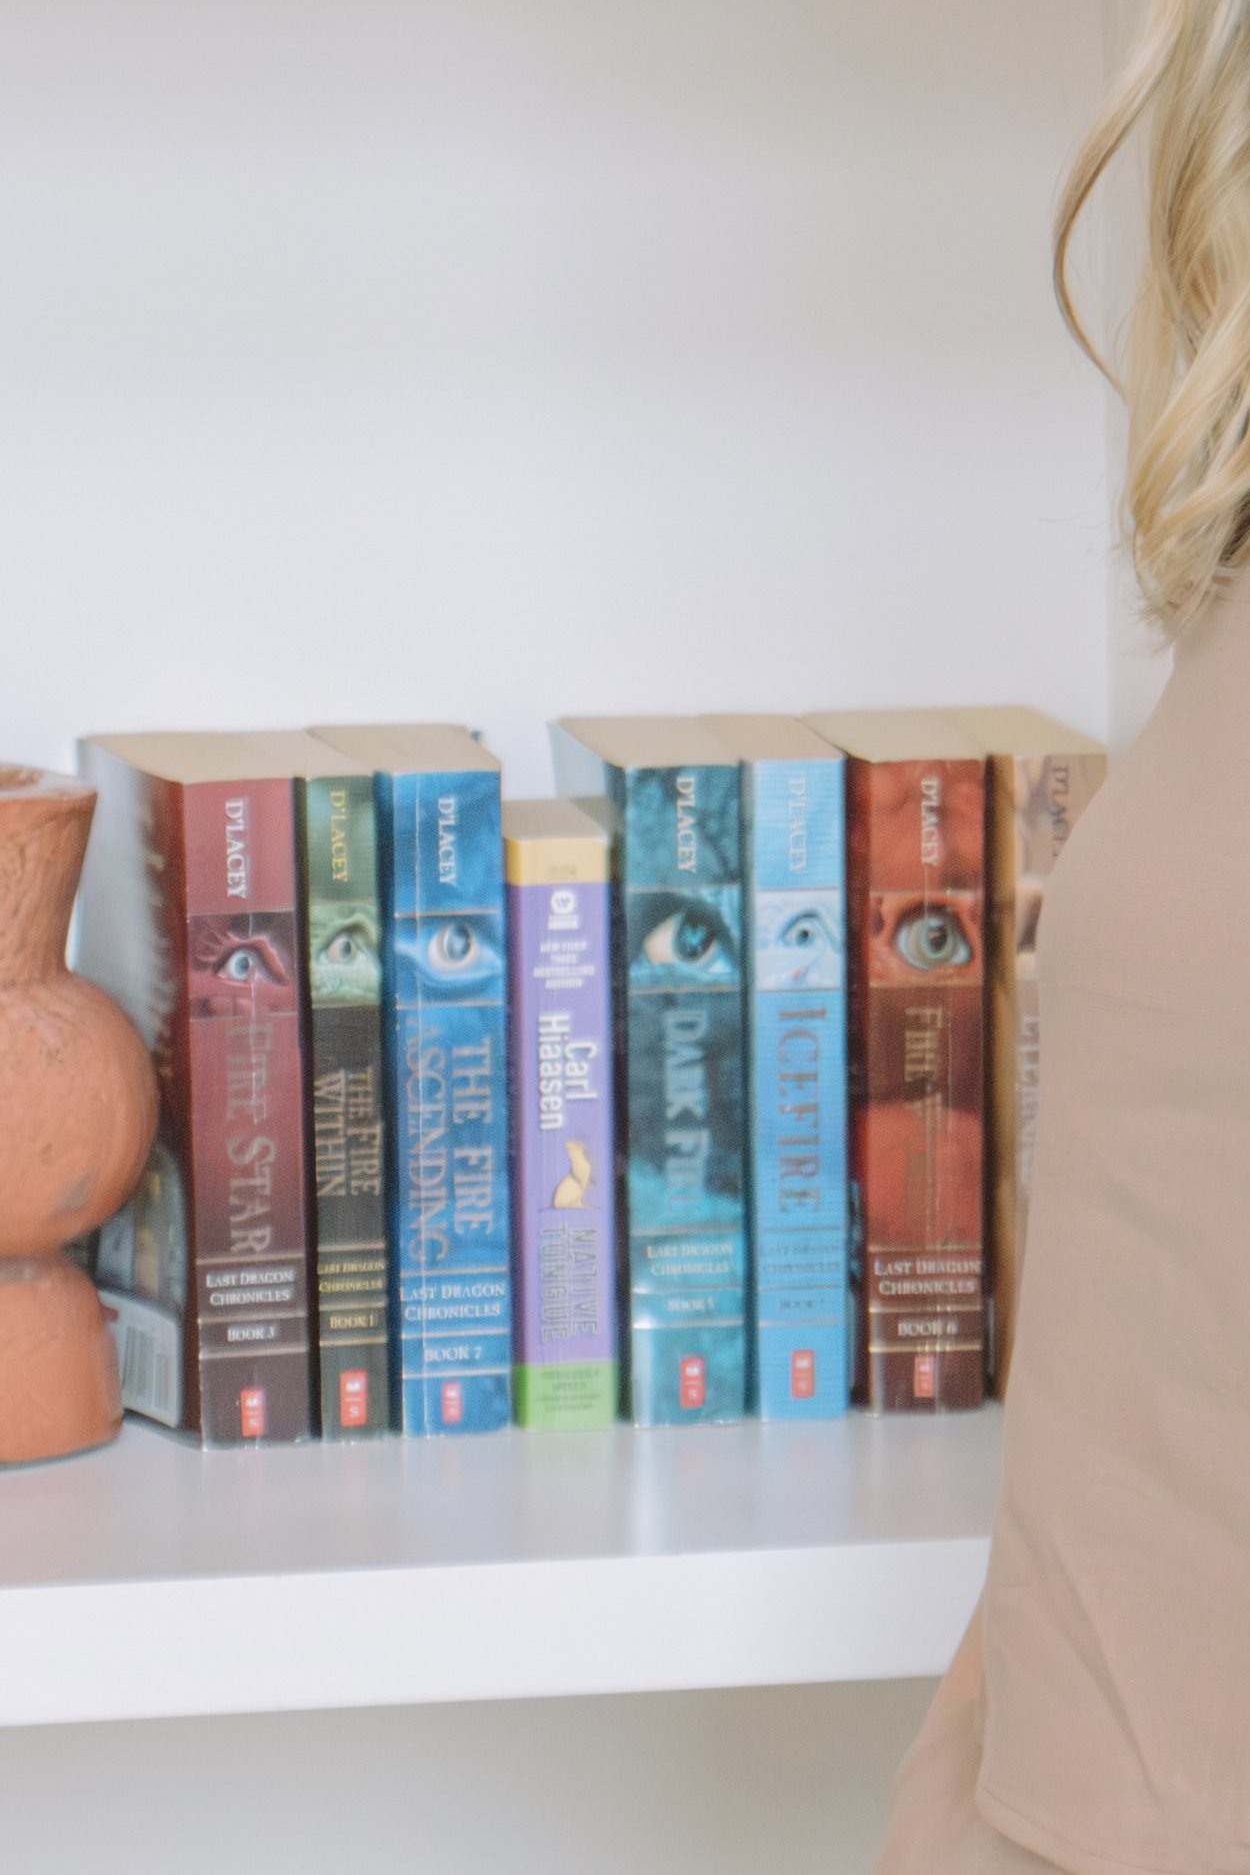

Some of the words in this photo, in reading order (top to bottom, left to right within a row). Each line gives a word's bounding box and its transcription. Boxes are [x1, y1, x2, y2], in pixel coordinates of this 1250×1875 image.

[225, 798, 248, 899] D'LACEY
[330, 789, 348, 883] D'LACEY
[437, 796, 457, 886] D'LACEY
[676, 775, 697, 873] D'LACEY
[920, 777, 941, 867] D'LACEY
[348, 1066, 373, 1119] THE
[452, 1037, 493, 1124] THE
[538, 1012, 571, 1131] Hiaasen
[564, 1040, 598, 1100] Carl
[777, 1007, 827, 1213] ICEFIRE
[314, 1069, 346, 1197] WITHIN
[348, 1124, 382, 1197] FIRE
[405, 1015, 449, 1263] ASCENDING
[226, 1136, 277, 1253] STAR
[453, 1146, 494, 1235] FIRE
[206, 1271, 238, 1288] LAST
[239, 1268, 295, 1285] DRAGON
[209, 1289, 292, 1306] CHRONICLES
[400, 1285, 437, 1302] LAST
[440, 1282, 507, 1300] DRAGON
[540, 1221, 569, 1343] TONGUE
[571, 1227, 599, 1335] NATIVE
[874, 1259, 912, 1275] LAST
[915, 1258, 982, 1274] DRAGON
[878, 1278, 977, 1295] CHRONICLES
[227, 1325, 264, 1342] BOOK
[330, 1315, 368, 1330] BOOK
[403, 1302, 502, 1321] CHRONICLES
[424, 1346, 469, 1363] BOOK
[898, 1319, 943, 1337] BOOK
